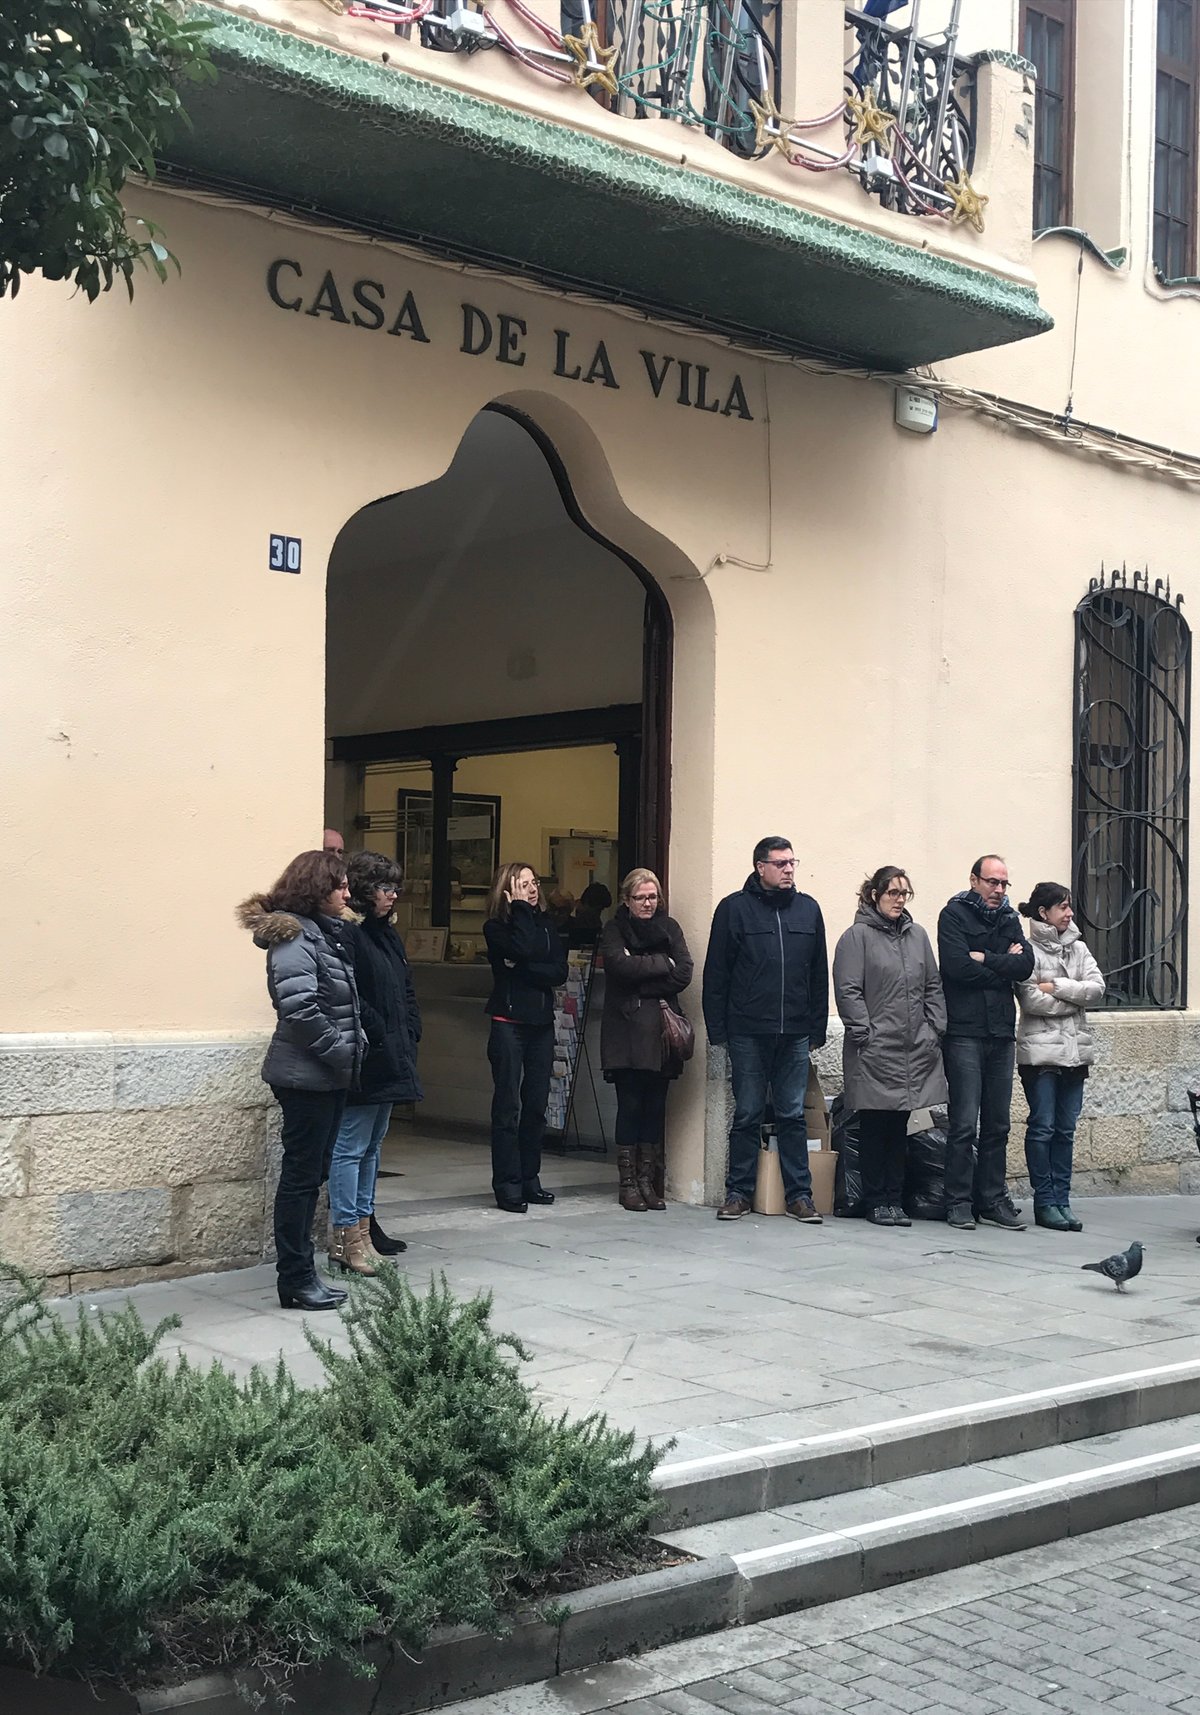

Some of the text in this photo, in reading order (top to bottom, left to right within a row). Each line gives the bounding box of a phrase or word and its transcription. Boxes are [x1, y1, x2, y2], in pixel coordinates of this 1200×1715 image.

[266, 258, 755, 420] CASA DE LA VILA
[271, 538, 300, 570] 30
